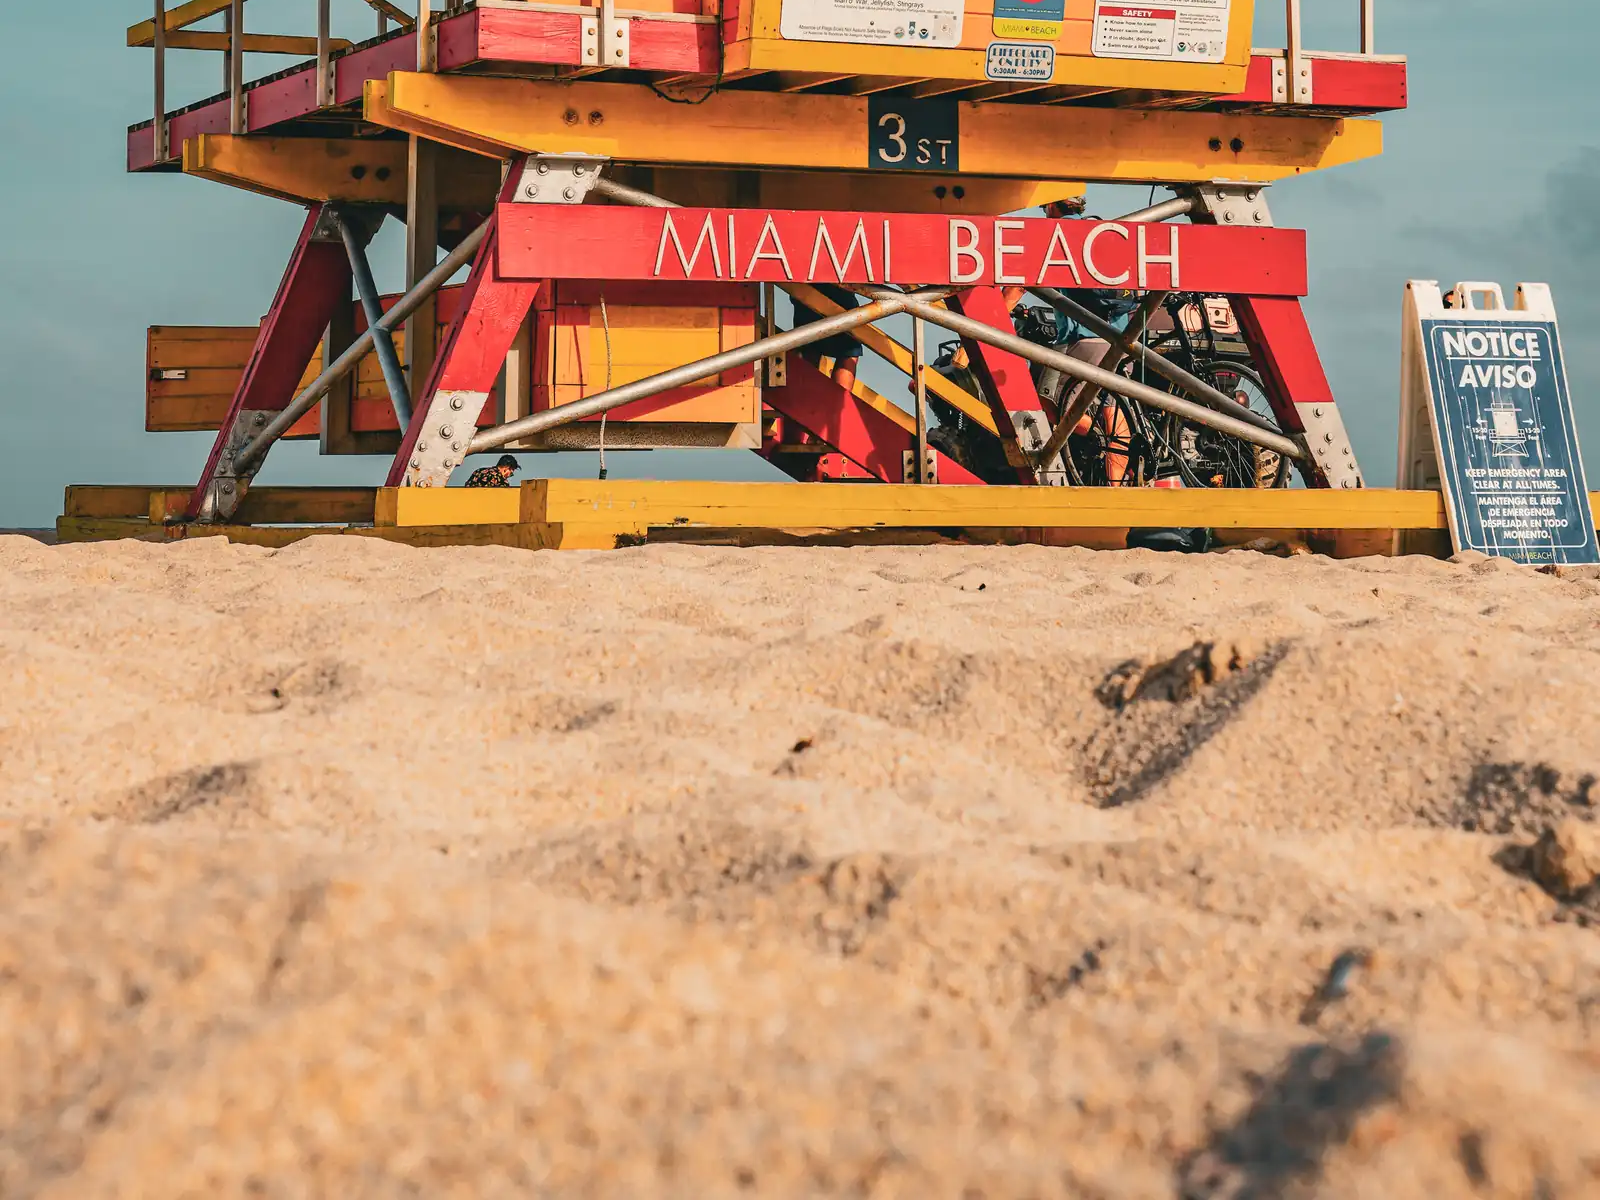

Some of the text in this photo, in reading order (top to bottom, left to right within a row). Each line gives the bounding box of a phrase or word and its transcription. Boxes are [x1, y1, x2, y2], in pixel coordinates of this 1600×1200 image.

[870, 0, 895, 7] Jellyfish,
[897, 0, 923, 8] Stingrays
[1122, 9, 1152, 18] SAFETY
[993, 47, 1049, 59] LIFEGUARD
[1015, 59, 1042, 67] DUTY
[993, 67, 1017, 75] 9:30AM
[878, 111, 953, 165] 3 ST
[653, 209, 1181, 289] MIAMI BEACH
[1442, 331, 1540, 357] NOTICE
[1458, 364, 1538, 389] AVISO
[1465, 468, 1567, 477] KEEP EMERGENCY AREA
[1474, 481, 1560, 489] CLEAR AT ALL TIMES.
[1479, 495, 1562, 505] MANTENGA EL ÁREA
[1490, 508, 1556, 517] DE EMERGENCIA
[1481, 519, 1529, 527] DESPEJADA
[1544, 519, 1568, 527] TODO
[1503, 531, 1550, 539] MOMENTO.
